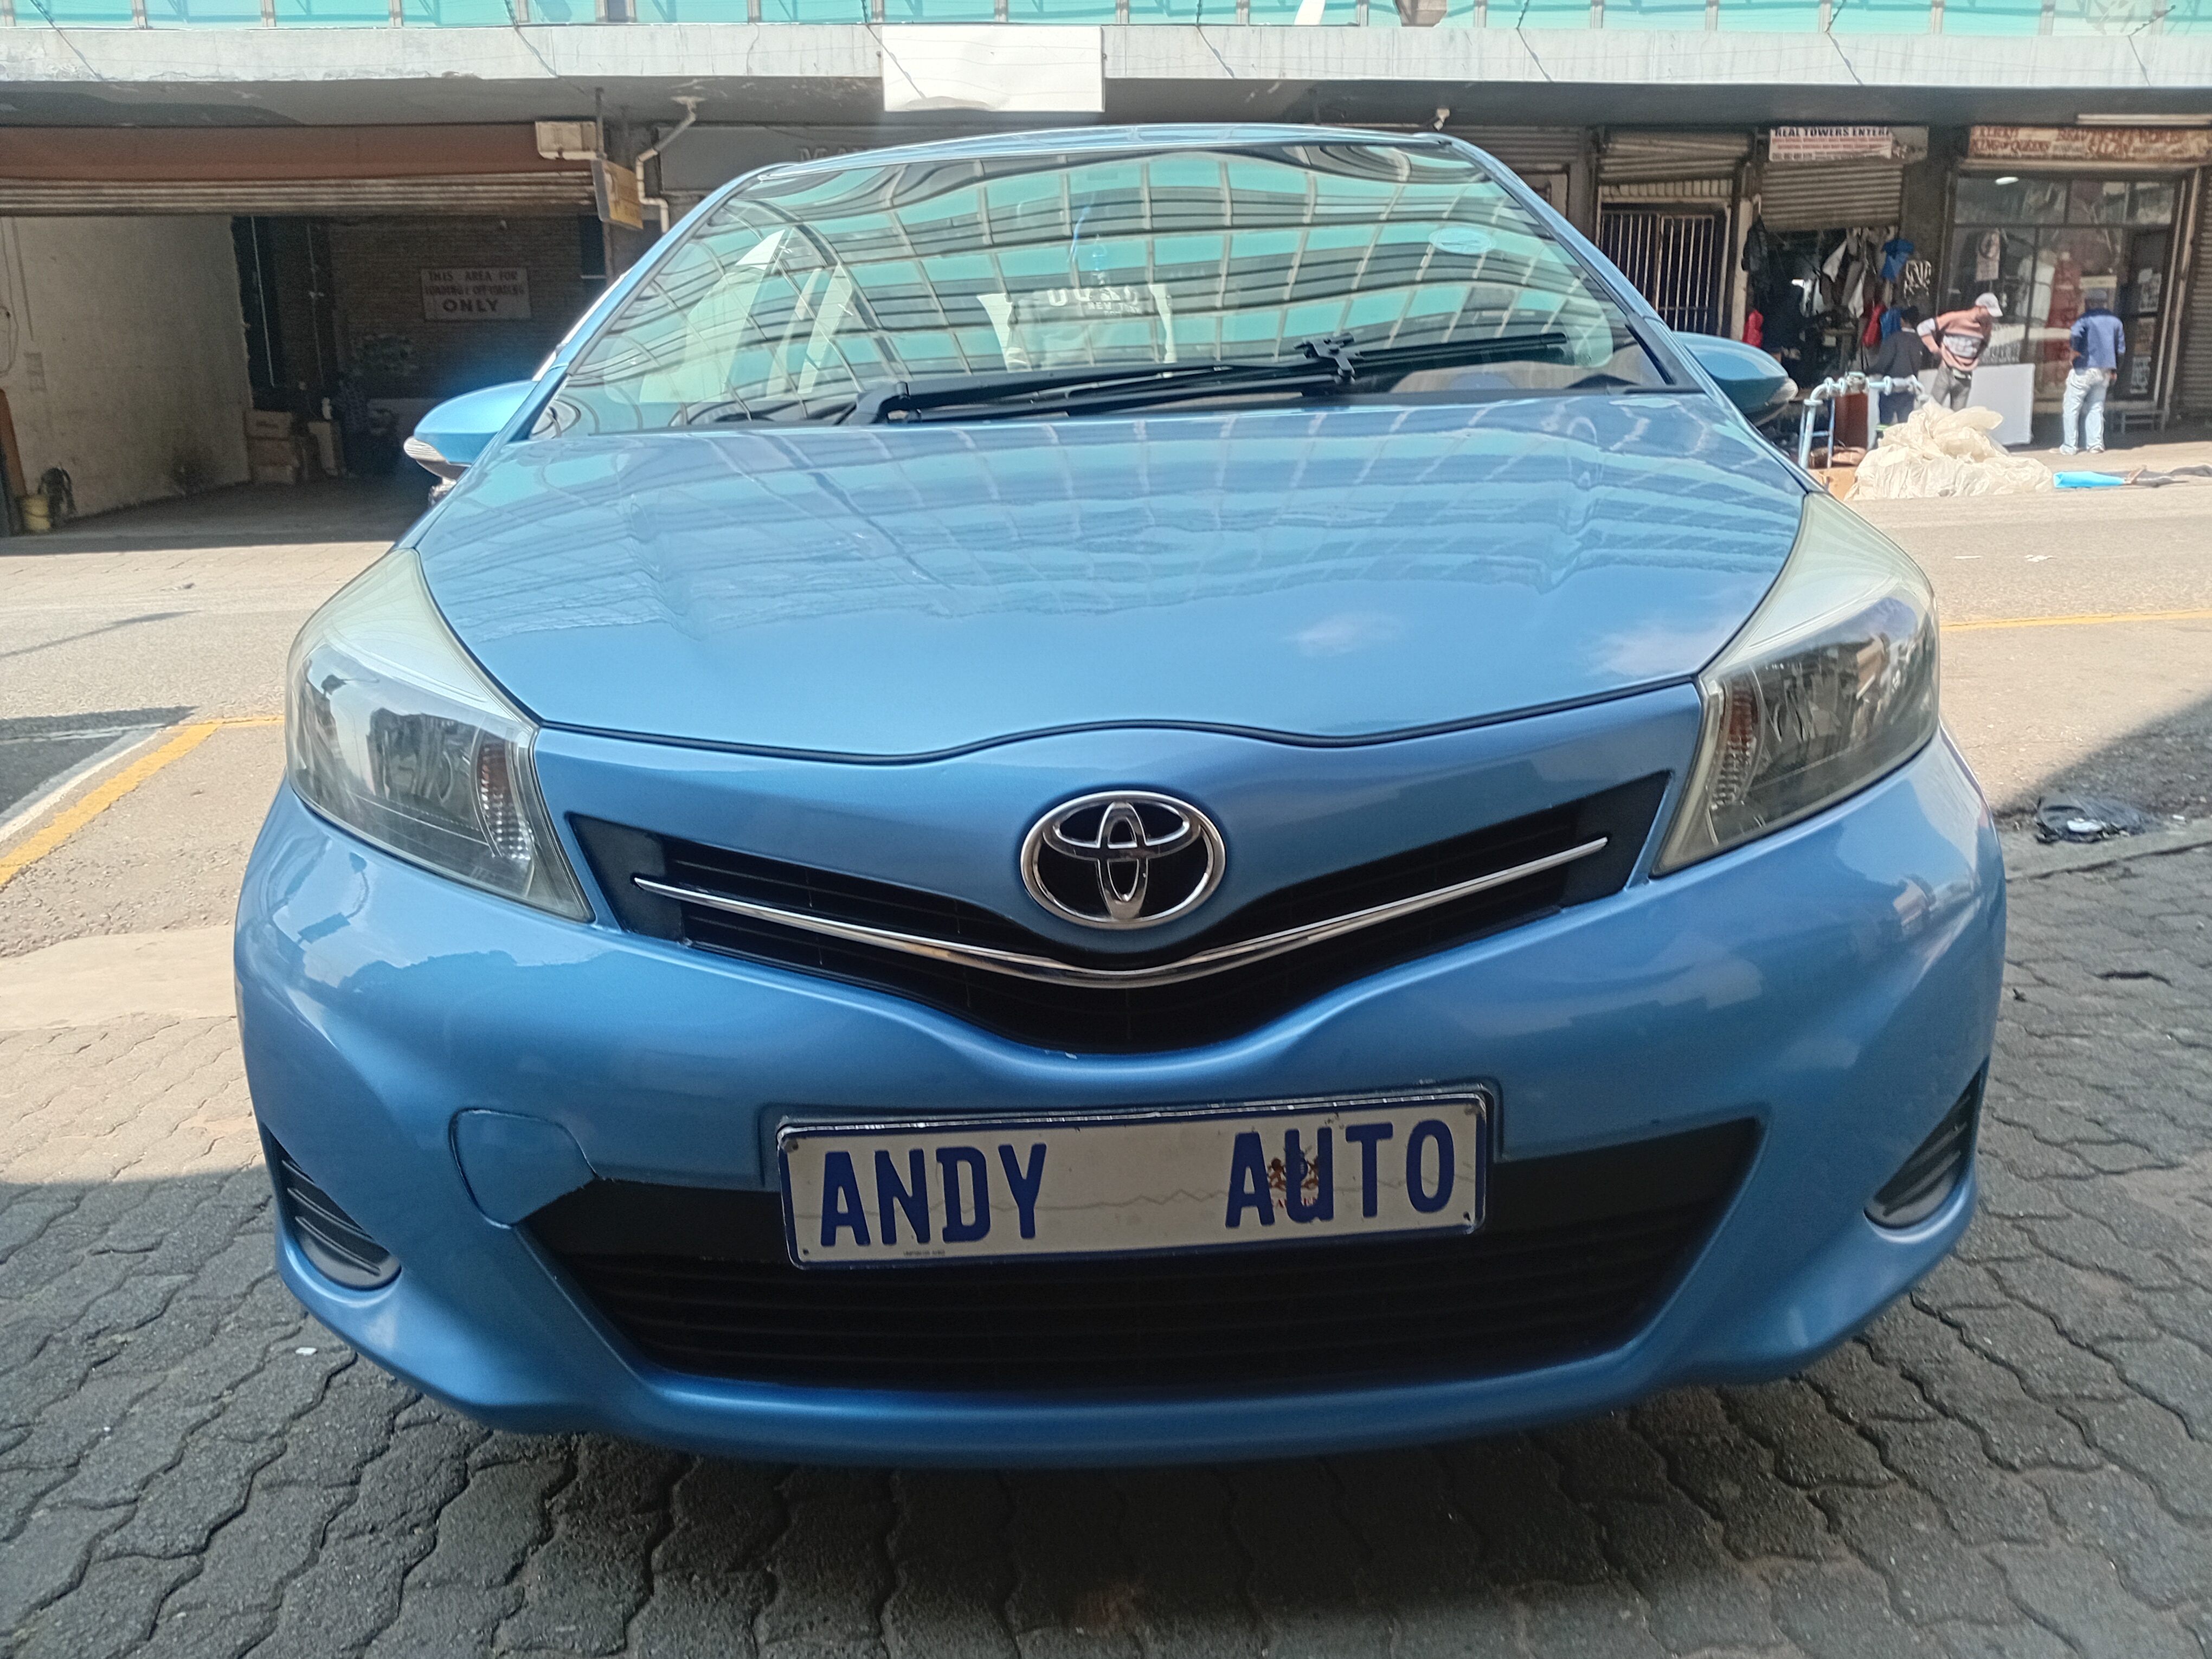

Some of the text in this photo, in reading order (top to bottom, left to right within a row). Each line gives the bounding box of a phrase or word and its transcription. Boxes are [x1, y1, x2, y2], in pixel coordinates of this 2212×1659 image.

[1774, 126, 1799, 136] REAL
[1804, 126, 1849, 136] TOWERS
[428, 271, 518, 281] THIS AREA FOR
[442, 299, 498, 312] ONLY
[820, 1118, 1454, 1248] ANDY AUTO
